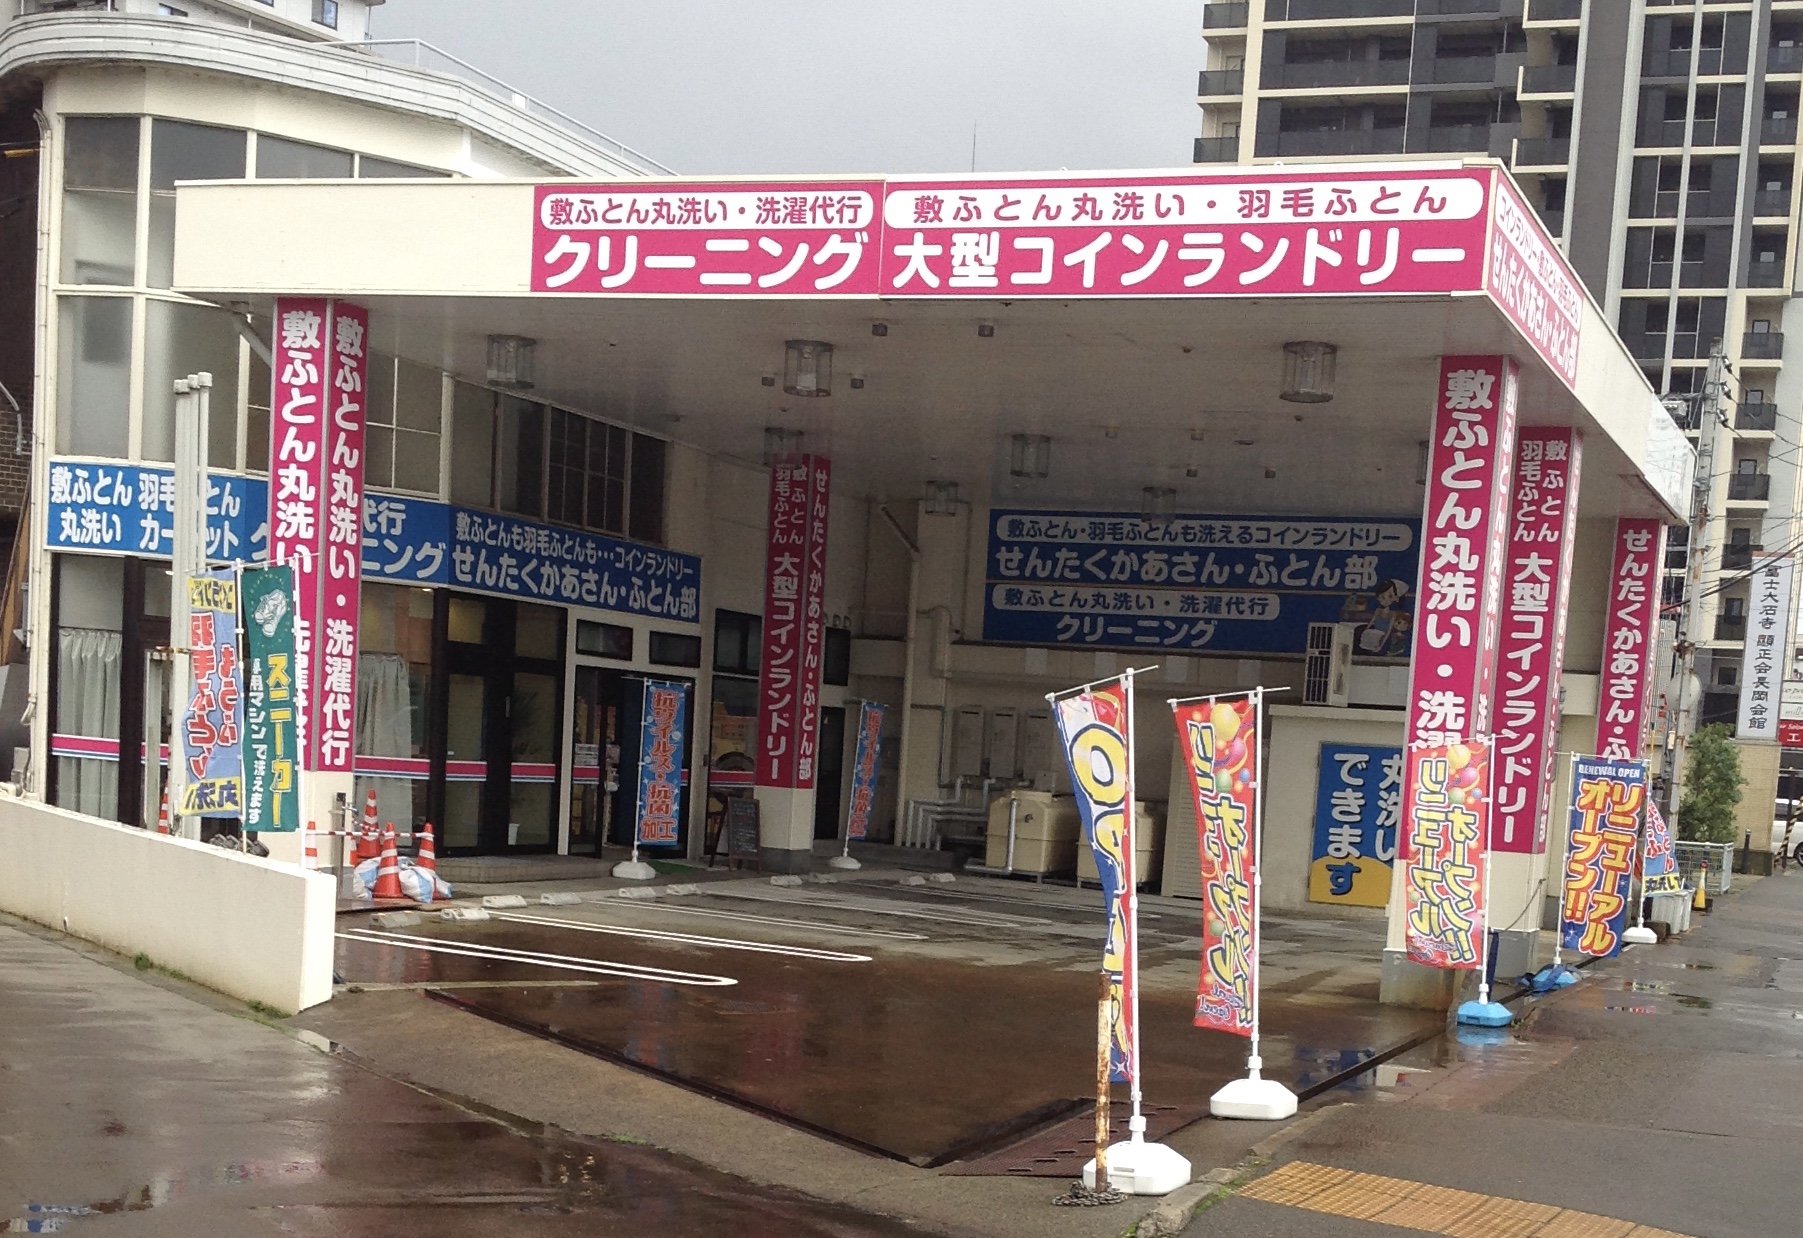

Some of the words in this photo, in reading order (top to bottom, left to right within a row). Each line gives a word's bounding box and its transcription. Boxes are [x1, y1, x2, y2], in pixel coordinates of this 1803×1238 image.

[549, 195, 862, 227] 敷ふとん丸洗い・洗濯代行
[913, 185, 1447, 225] 敷ふとん丸洗い・羽毛ふとん
[543, 231, 870, 290] クリーニング
[892, 226, 1466, 291] 大型コインランドリー
[51, 466, 133, 507] 敷ふとん
[138, 472, 241, 518] 羽毛とん
[1513, 440, 1543, 543] 羽毛ふとん
[1537, 440, 1567, 543] 敷ふとん
[60, 506, 122, 544] 丸洗い
[140, 512, 239, 558] カーット
[321, 315, 364, 767] 敷ふとん丸洗い・洗濯代行
[1006, 517, 1400, 547] 敷ふとん・羽毛ふとんも洗えるコインランドリー
[453, 545, 698, 618] せんたくかあさん・ふとん部
[995, 547, 1380, 590] せんたくかあさん・ふとん部
[799, 468, 828, 780] せんたくかあさん・ふとん部
[1004, 585, 1269, 616] 敷ふとん丸洗い・洗濯代行
[1056, 613, 1218, 647] クリーニング
[766, 552, 800, 780] 大型コインランドリー
[1497, 552, 1554, 844] 大型コインランドリー
[266, 653, 293, 828] スニーカー
[1617, 766, 1641, 779] OPEN
[1326, 752, 1370, 896] できます
[1580, 783, 1646, 956] リニューアル
